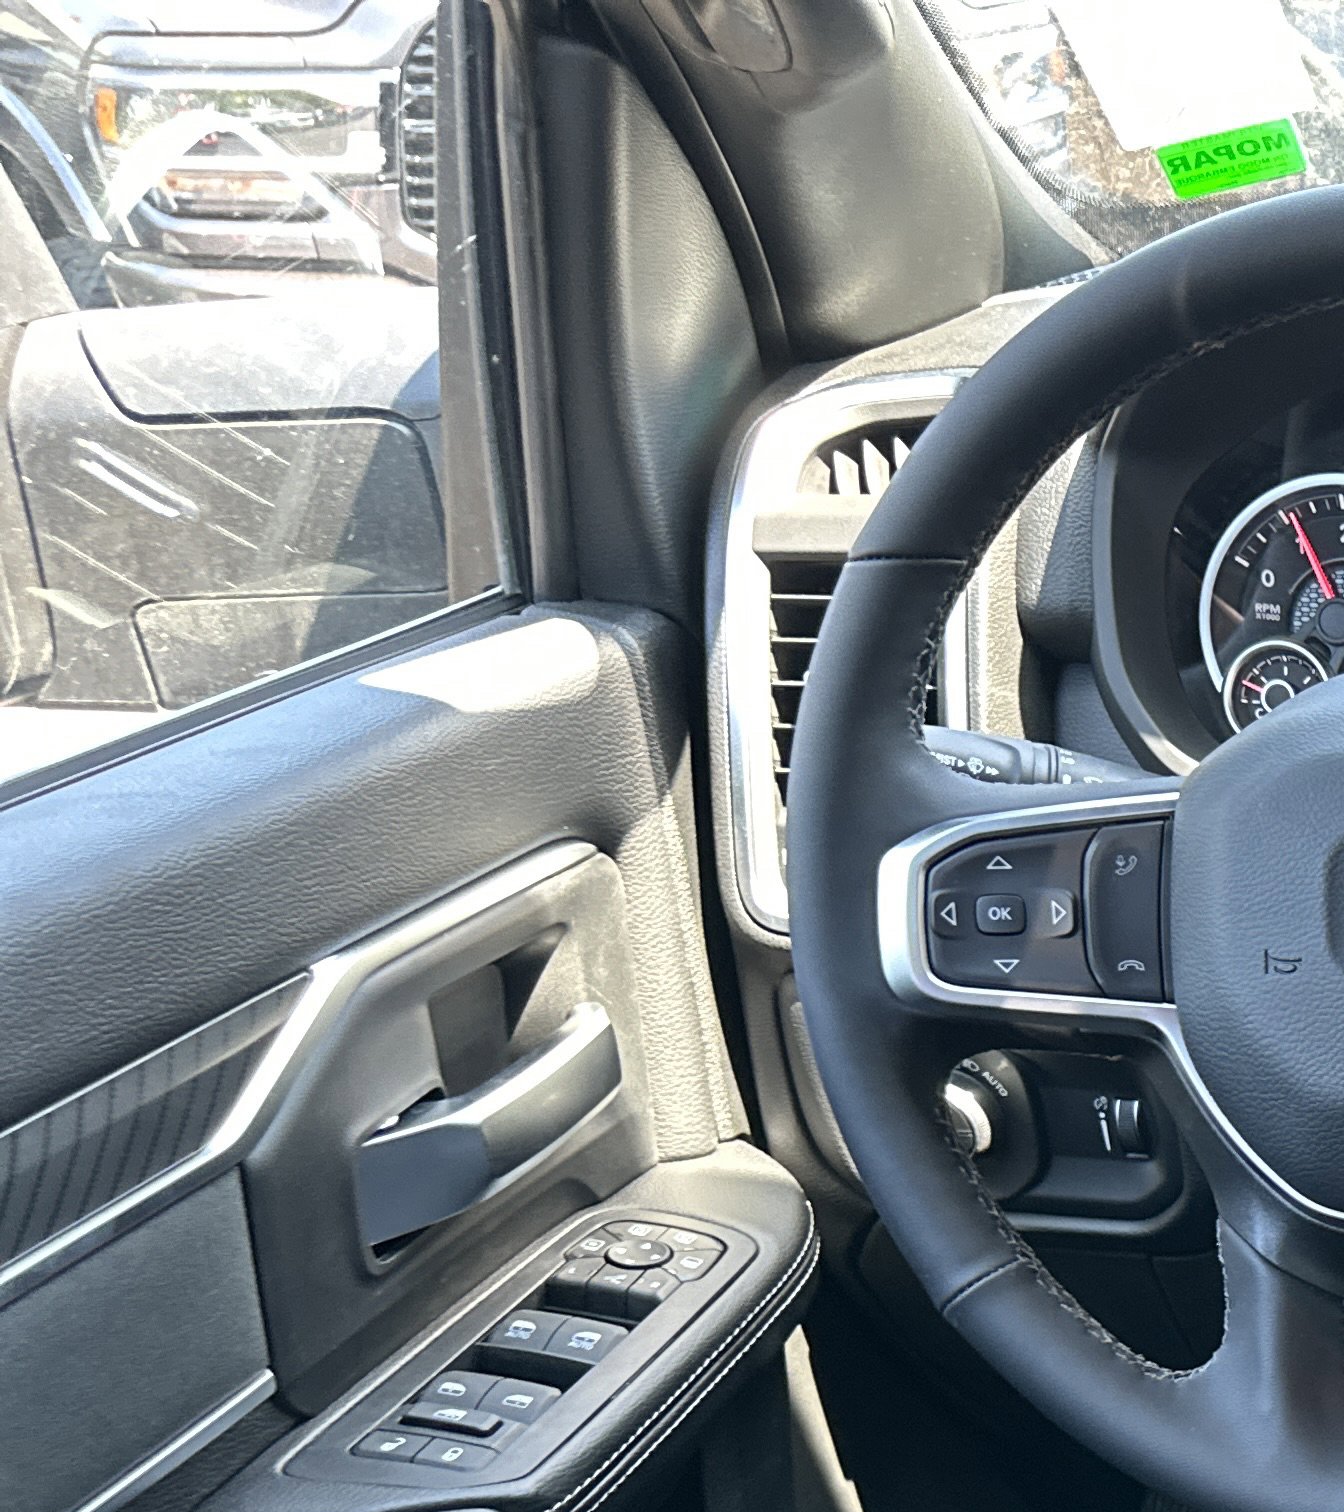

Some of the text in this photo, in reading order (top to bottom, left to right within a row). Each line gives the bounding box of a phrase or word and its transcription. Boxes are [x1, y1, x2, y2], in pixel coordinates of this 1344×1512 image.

[1260, 569, 1276, 587] 0
[1255, 602, 1281, 614] RPM
[988, 907, 1013, 922] OK
[982, 1070, 1008, 1097] AUTO
